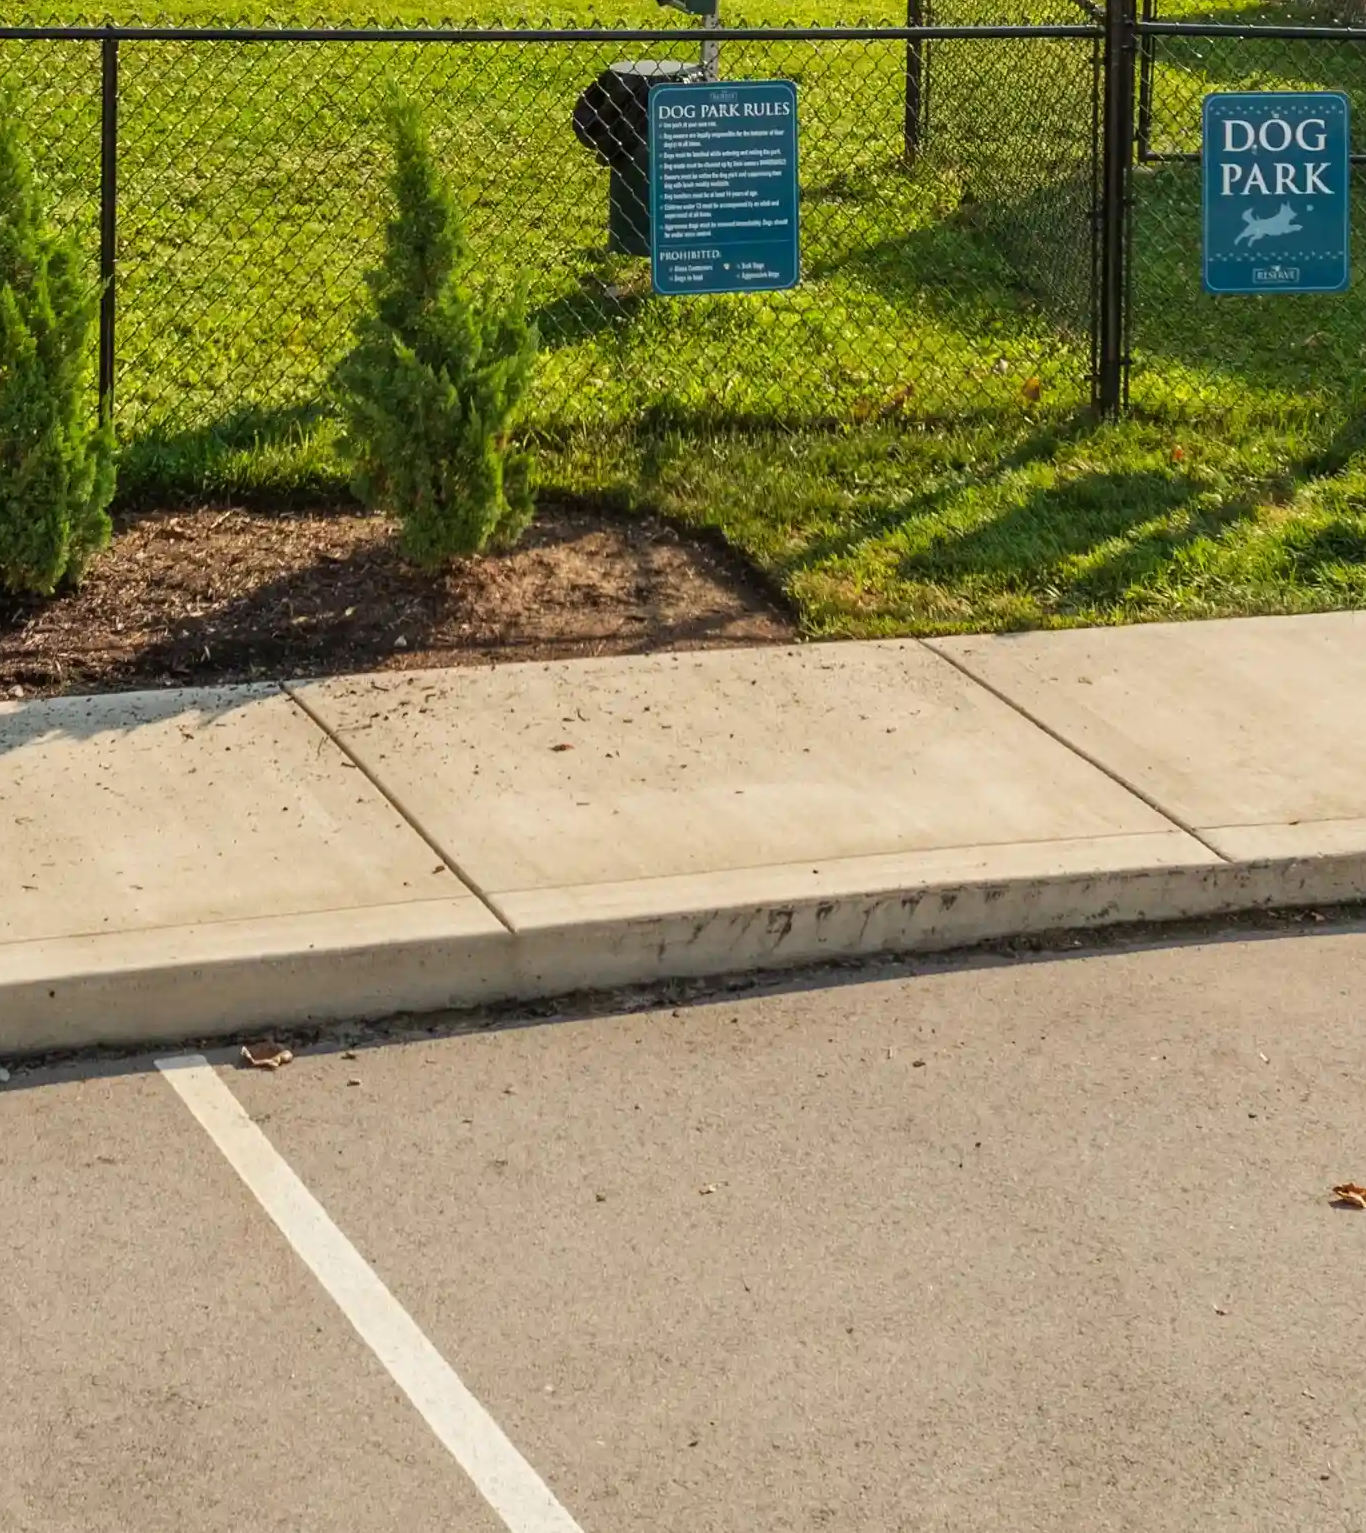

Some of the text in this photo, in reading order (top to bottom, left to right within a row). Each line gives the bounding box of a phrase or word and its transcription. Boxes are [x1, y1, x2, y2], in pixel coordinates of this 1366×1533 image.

[659, 102, 790, 120] DOG PARK RULES
[1222, 119, 1327, 152] DOG
[1221, 163, 1335, 195] PARK
